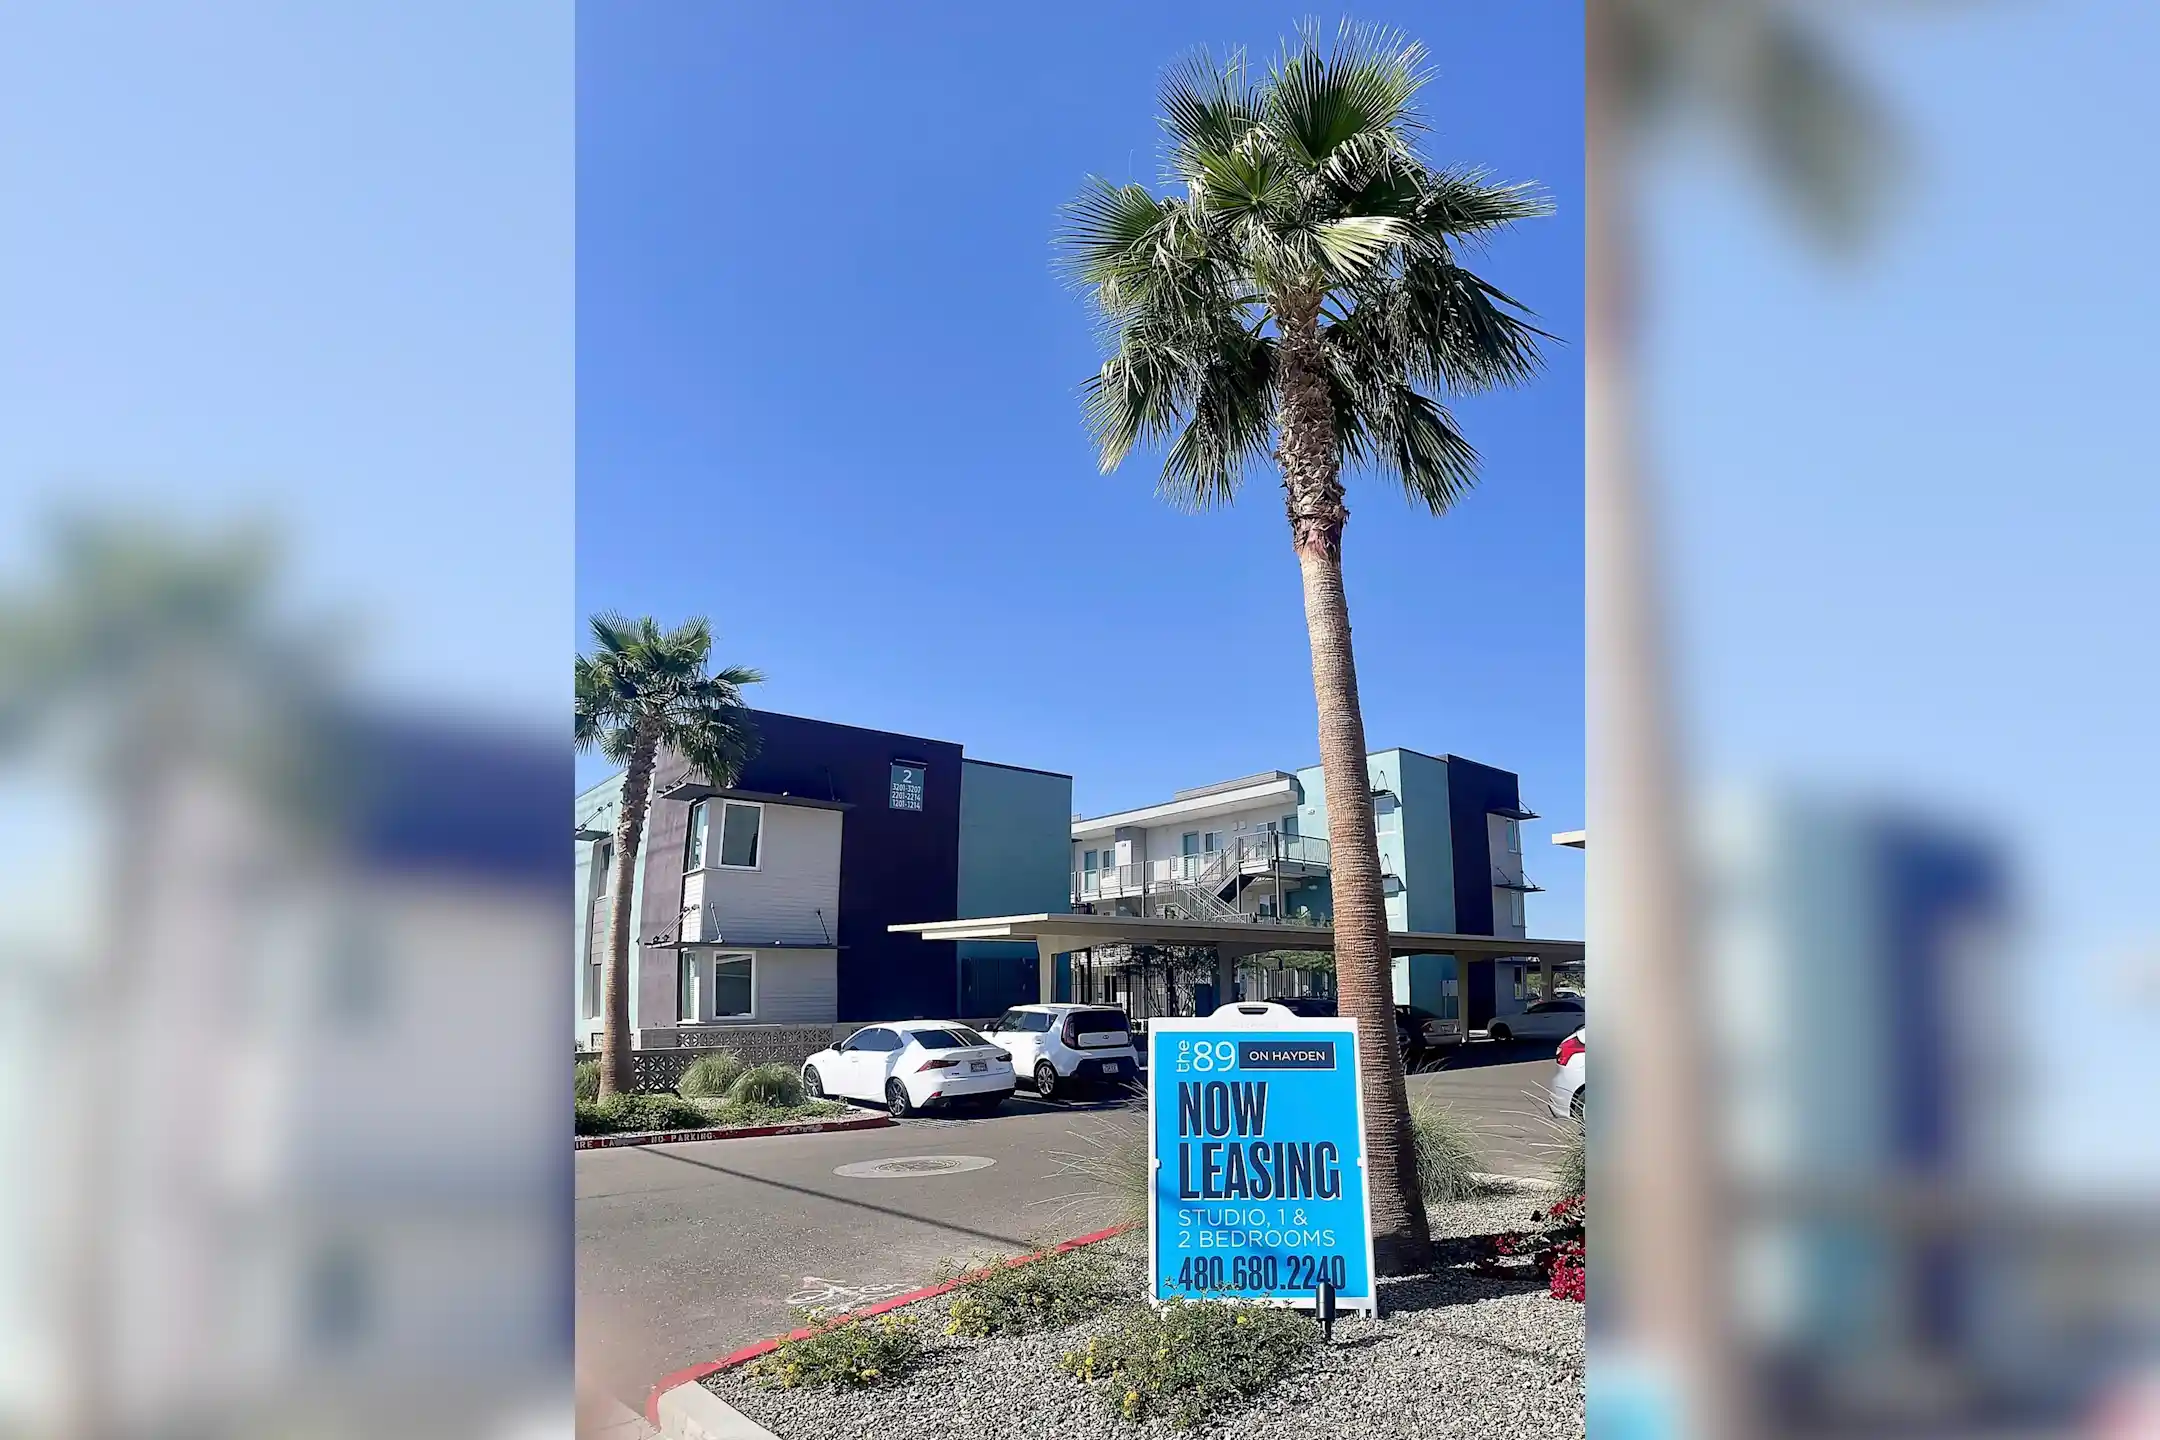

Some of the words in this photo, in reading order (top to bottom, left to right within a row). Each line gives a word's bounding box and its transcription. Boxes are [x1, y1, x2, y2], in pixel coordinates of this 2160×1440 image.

[903, 770, 912, 783] 2
[892, 783, 921, 793] 3201-3207
[892, 791, 921, 801] 2201-2214
[892, 799, 921, 809] 1201-1214
[1176, 1040, 1190, 1073] the
[1193, 1041, 1236, 1072] 89
[1249, 1051, 1268, 1061] ON
[1272, 1050, 1326, 1062] HAYDEN
[1178, 1080, 1268, 1138] NOW
[576, 1140, 594, 1149] IRE
[651, 1135, 664, 1143] NO
[670, 1132, 713, 1142] PARKING
[1179, 1141, 1342, 1200] LEASING
[1178, 1208, 1271, 1228] STUDIO,
[1278, 1208, 1286, 1225] 1
[1293, 1208, 1308, 1226] &
[1178, 1231, 1191, 1248] 2
[1199, 1230, 1336, 1248] BEDROOMS
[1178, 1255, 1346, 1291] 480680.2240
